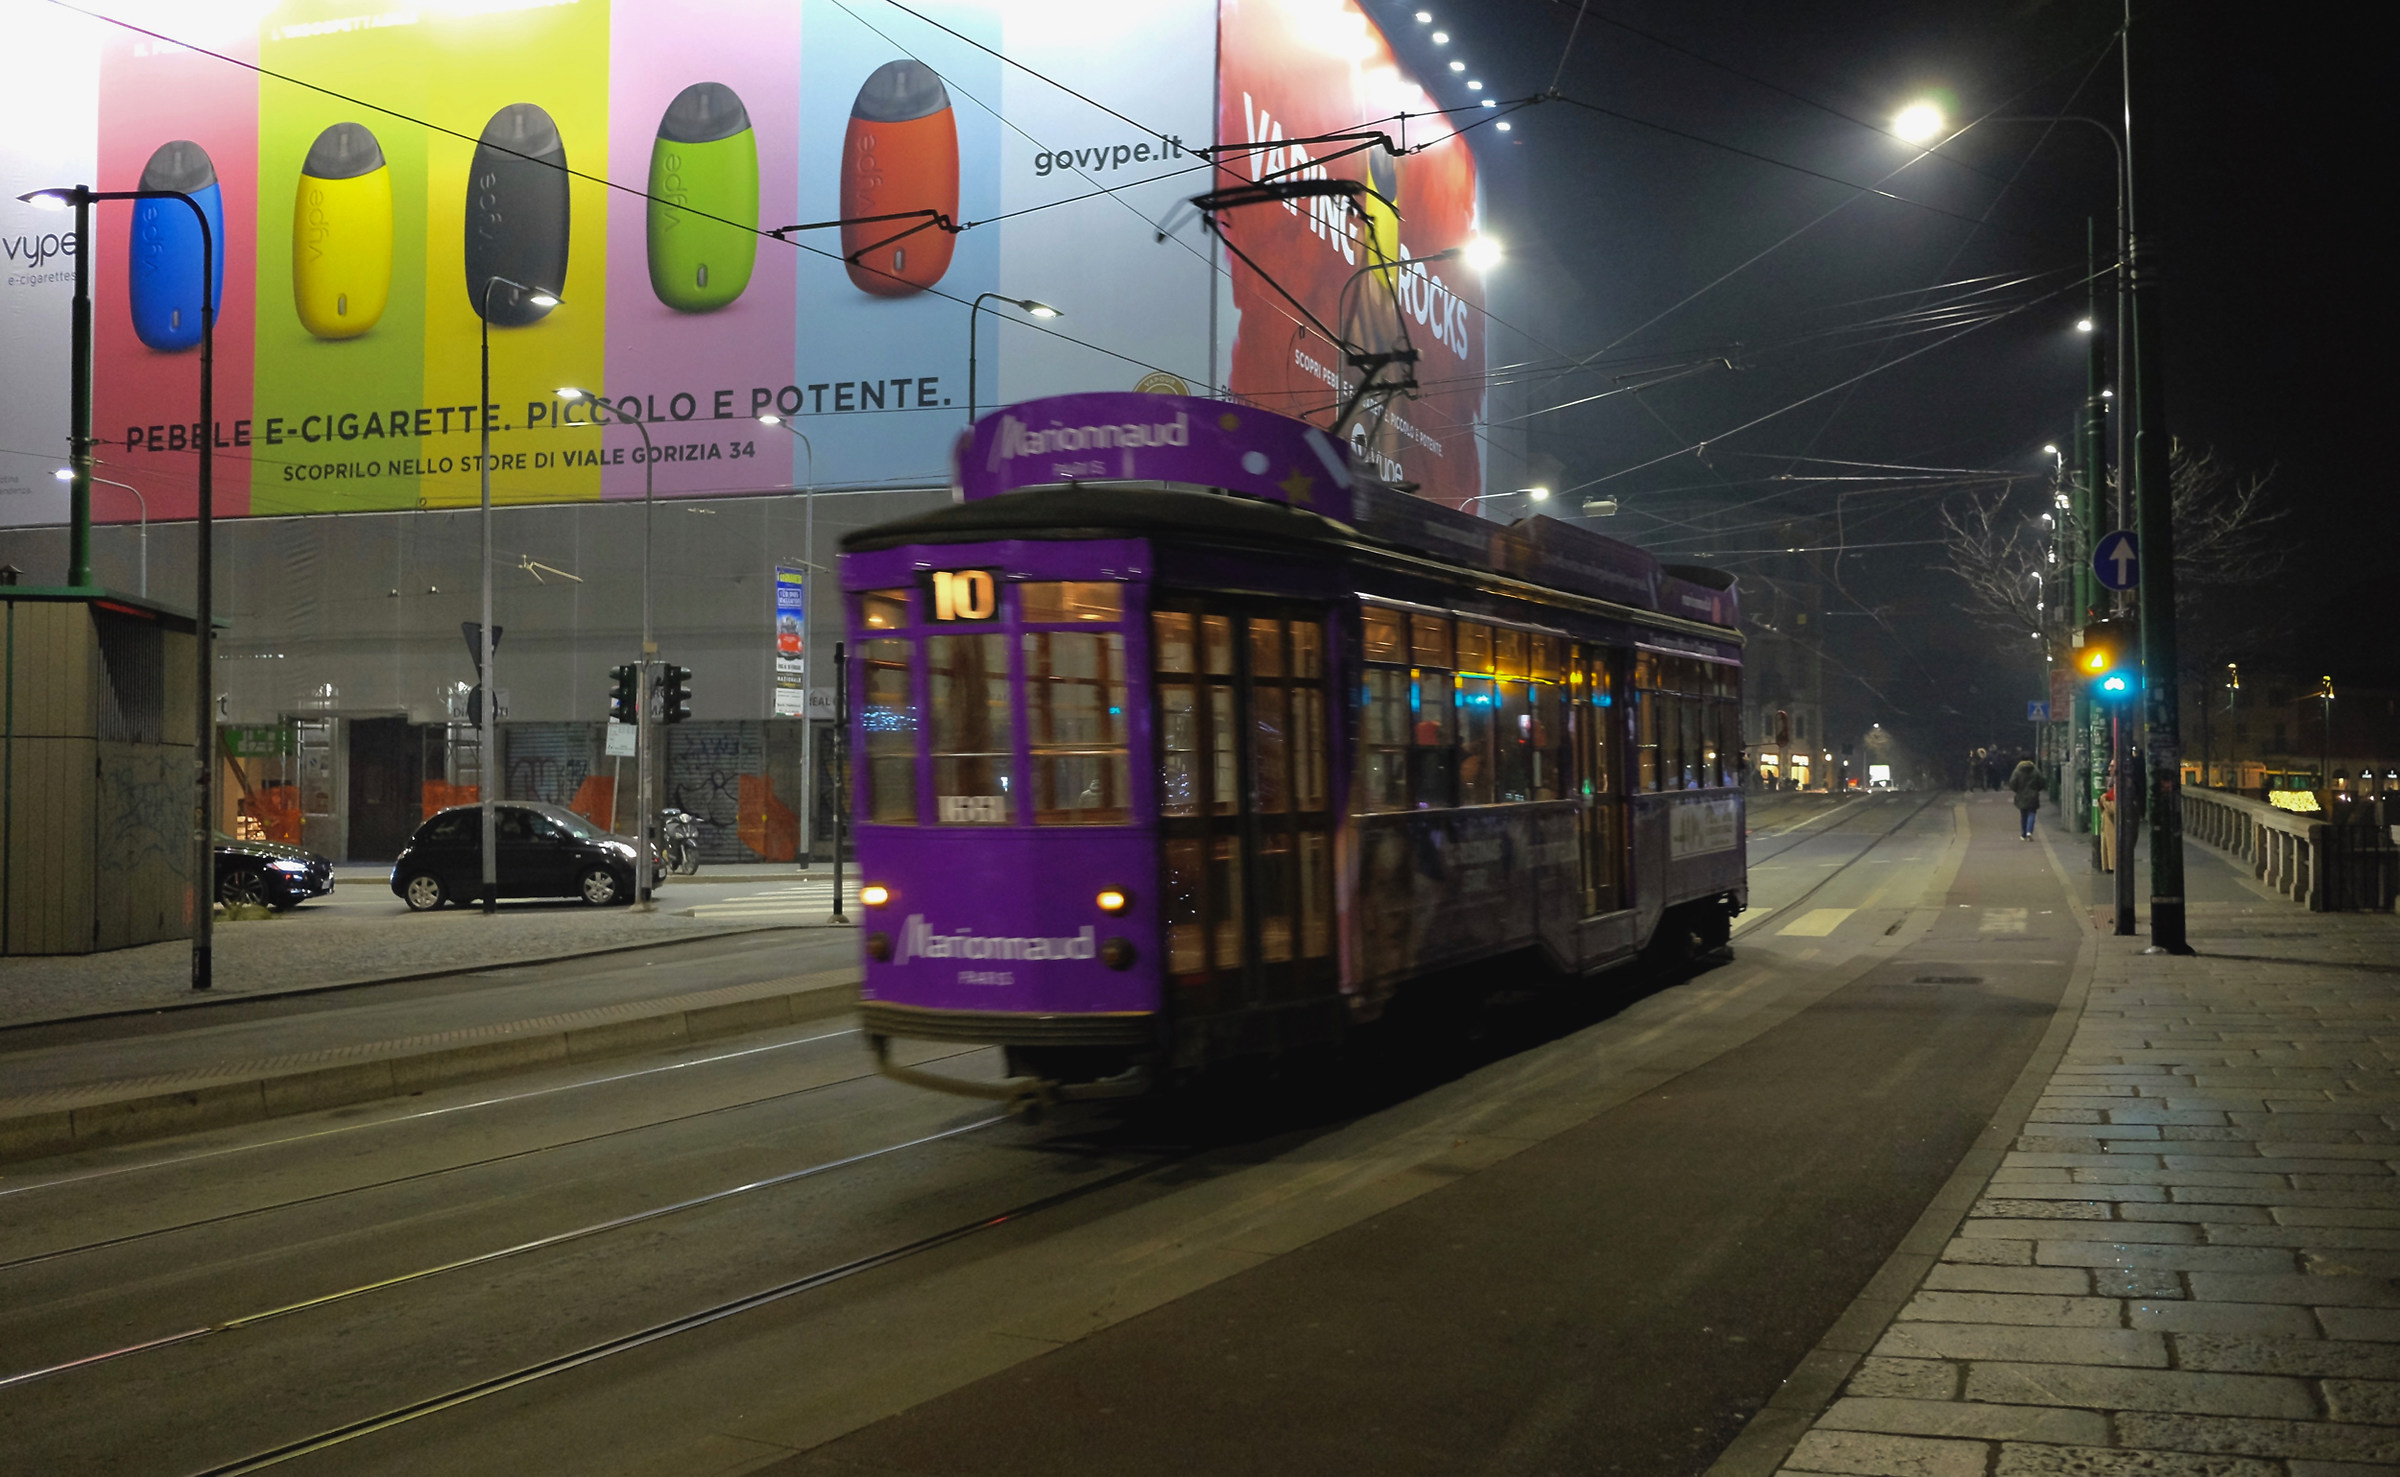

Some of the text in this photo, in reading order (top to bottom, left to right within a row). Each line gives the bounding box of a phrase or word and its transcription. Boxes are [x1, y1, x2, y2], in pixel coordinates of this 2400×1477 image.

[1034, 134, 1183, 177] govype.it
[1243, 91, 1358, 266] VAPING
[663, 153, 688, 233] vype
[2, 232, 78, 268] vype
[309, 189, 329, 264] vype
[8, 271, 77, 288] e-cigarettes
[1398, 243, 1468, 361] ROCKS
[265, 404, 512, 446] E-CIGARETTE.
[527, 393, 697, 430] PICCOLO
[713, 390, 734, 419] E
[752, 376, 951, 418] POTENTE.
[283, 440, 756, 481] SCOPRILO NELLO STORE DI VIALE GORIZIA 34
[986, 411, 1189, 473] Marionnaud
[932, 569, 995, 620] 10
[893, 913, 1096, 966] Marionnaud
